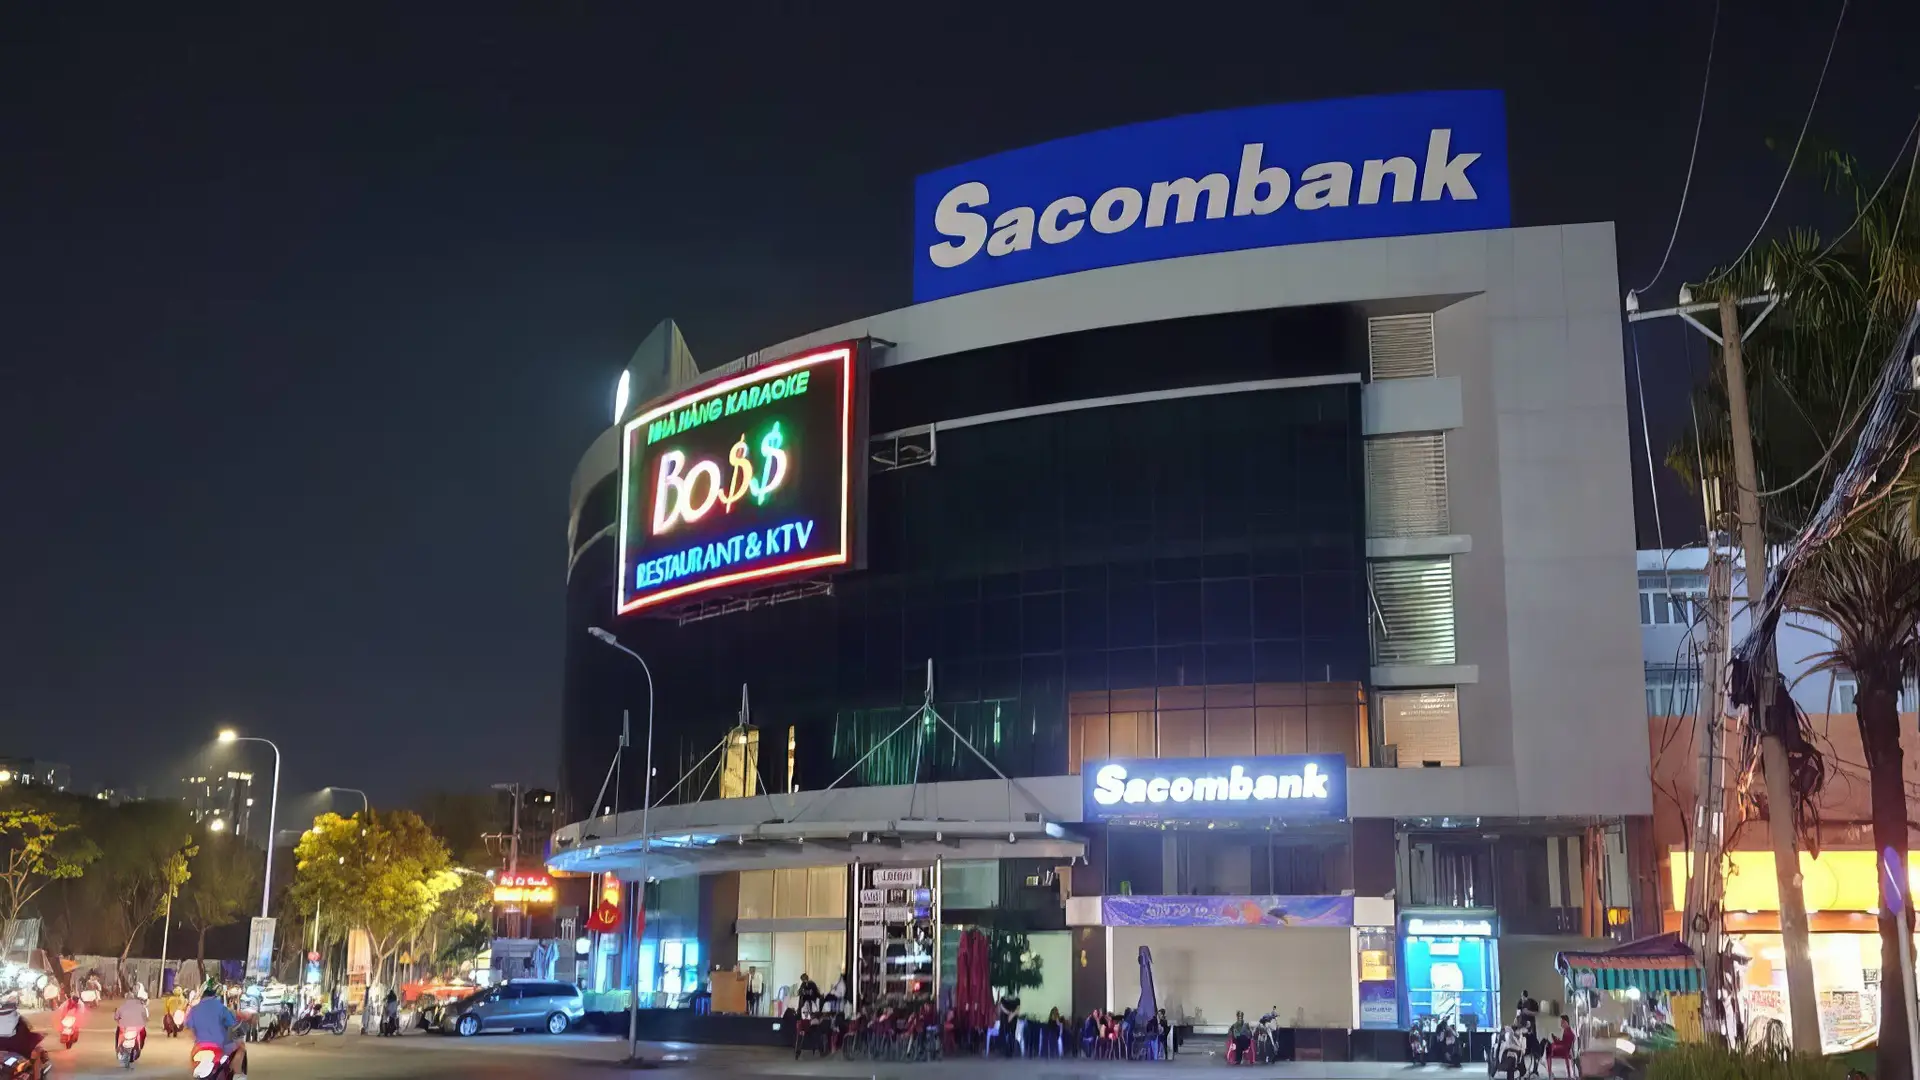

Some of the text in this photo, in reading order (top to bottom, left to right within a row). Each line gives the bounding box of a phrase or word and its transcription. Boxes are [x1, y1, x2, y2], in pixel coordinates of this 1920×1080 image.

[929, 128, 1482, 268] Sacombank
[725, 371, 810, 416] KARAOKE
[636, 520, 814, 589] RESTAURANT & KTV
[1094, 763, 1328, 804] Sacombank
